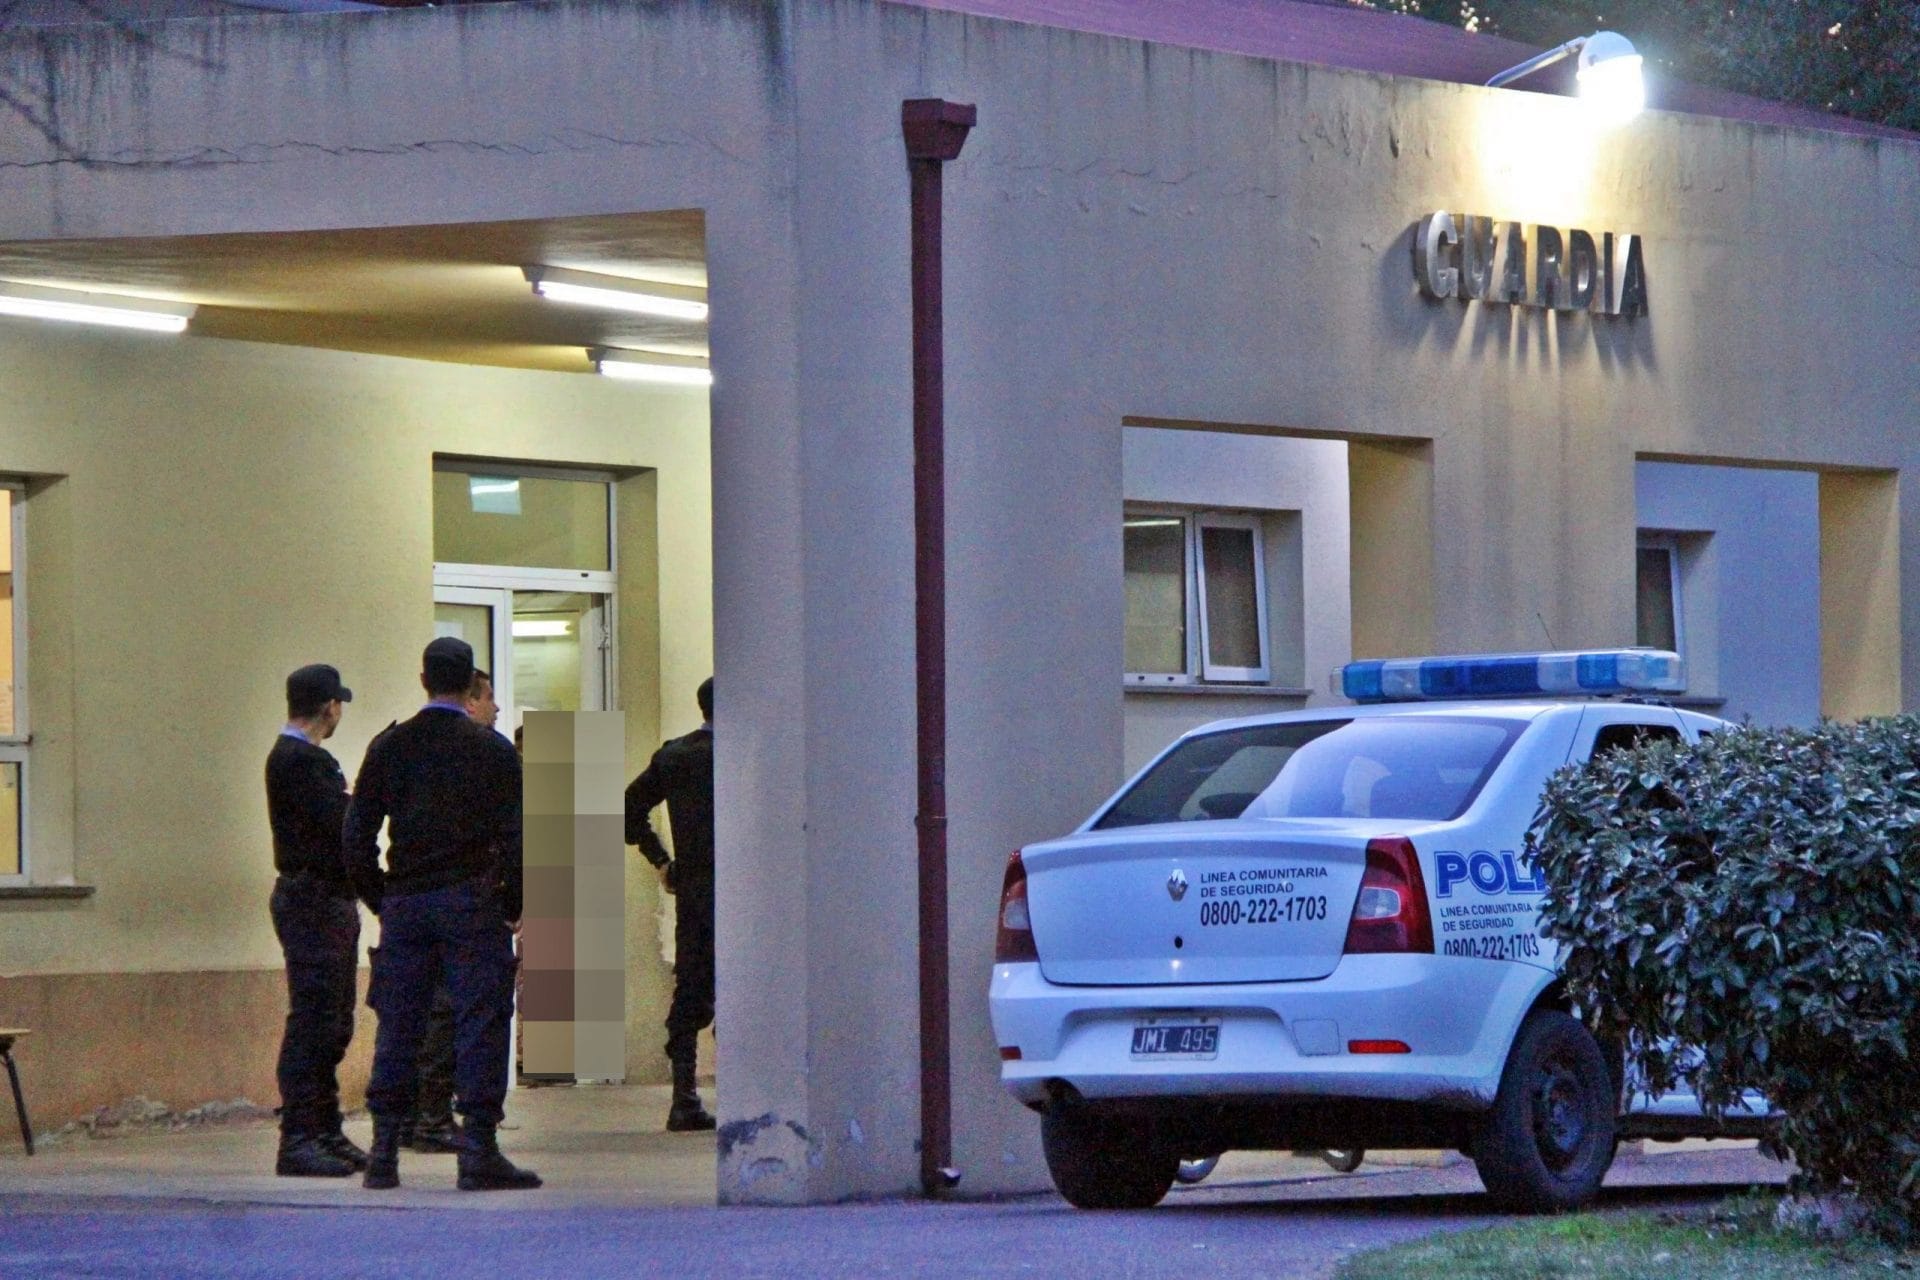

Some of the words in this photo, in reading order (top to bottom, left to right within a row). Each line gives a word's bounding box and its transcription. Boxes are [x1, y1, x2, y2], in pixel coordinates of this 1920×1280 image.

[1414, 210, 1649, 318] GUARDIA
[1201, 871, 1236, 884] LINEA
[1239, 867, 1328, 881] COMUNITARIA
[1201, 886, 1216, 898] DE
[1220, 882, 1294, 897] SEGURIDAD
[1200, 896, 1327, 926] 0800-222-1703
[1440, 907, 1469, 918] LINEA
[1471, 903, 1533, 916] COMUNITARIA
[1442, 921, 1457, 932] DE
[1459, 917, 1514, 931] SEGURIDAD
[1444, 933, 1539, 960] 0800-222-1703
[1134, 1029, 1169, 1052] JMI
[1180, 1028, 1216, 1050] 495
